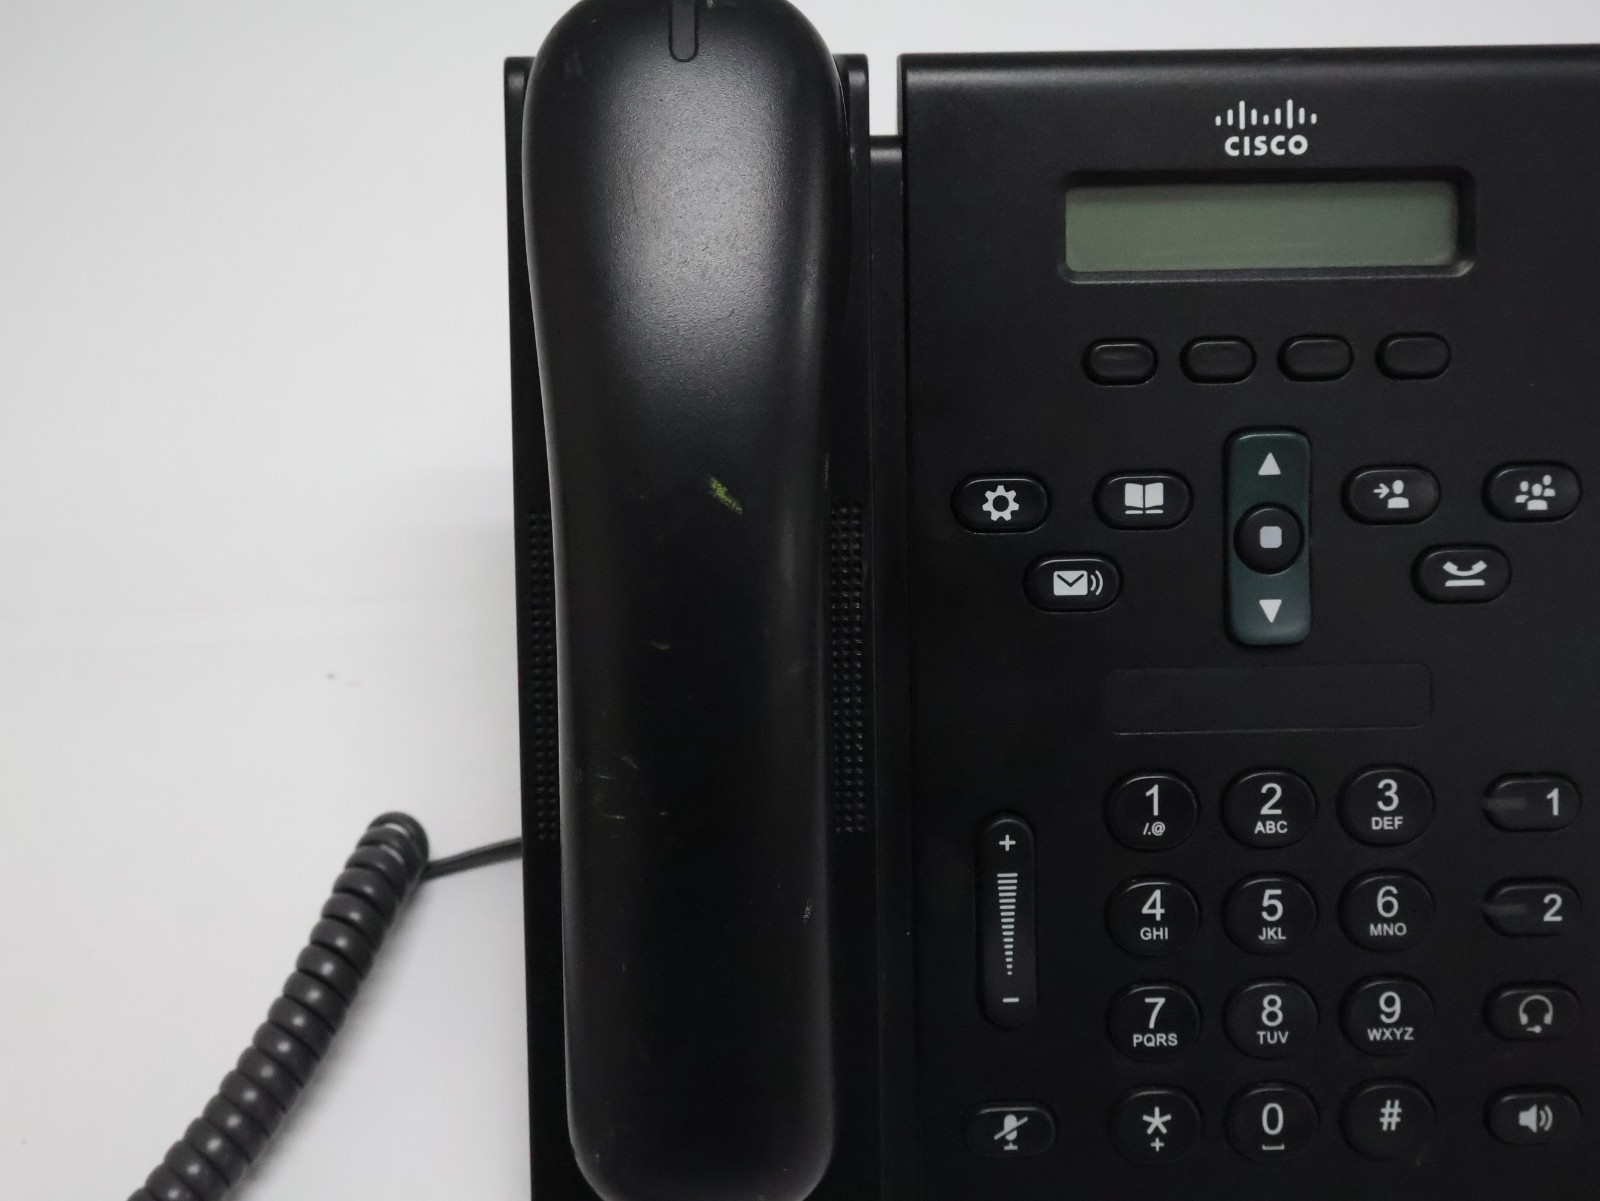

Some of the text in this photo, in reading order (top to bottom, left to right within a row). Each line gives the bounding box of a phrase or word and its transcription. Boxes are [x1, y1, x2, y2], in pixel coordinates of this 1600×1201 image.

[1225, 135, 1308, 156] CISCO
[1146, 785, 1158, 816] 1
[1260, 783, 1282, 814] 2
[1377, 779, 1399, 811] 3
[1547, 788, 1559, 816] 1
[1255, 821, 1287, 833] ABC
[1372, 817, 1403, 830] DEF
[1141, 889, 1165, 920] 4
[1262, 889, 1283, 921] 5
[1377, 886, 1398, 917] 6
[1544, 894, 1562, 921] 2
[1140, 927, 1168, 940] GHI
[1259, 927, 1286, 940] JKL
[1370, 923, 1406, 936] MNO
[1145, 997, 1165, 1029] 7
[1262, 995, 1283, 1026] 8
[1379, 992, 1401, 1023] 9
[1133, 1033, 1177, 1047] PQRS
[1257, 1031, 1288, 1044] TUV
[1368, 1027, 1413, 1040] WXYZ
[1262, 1103, 1283, 1135] 0
[1380, 1100, 1402, 1131] #
